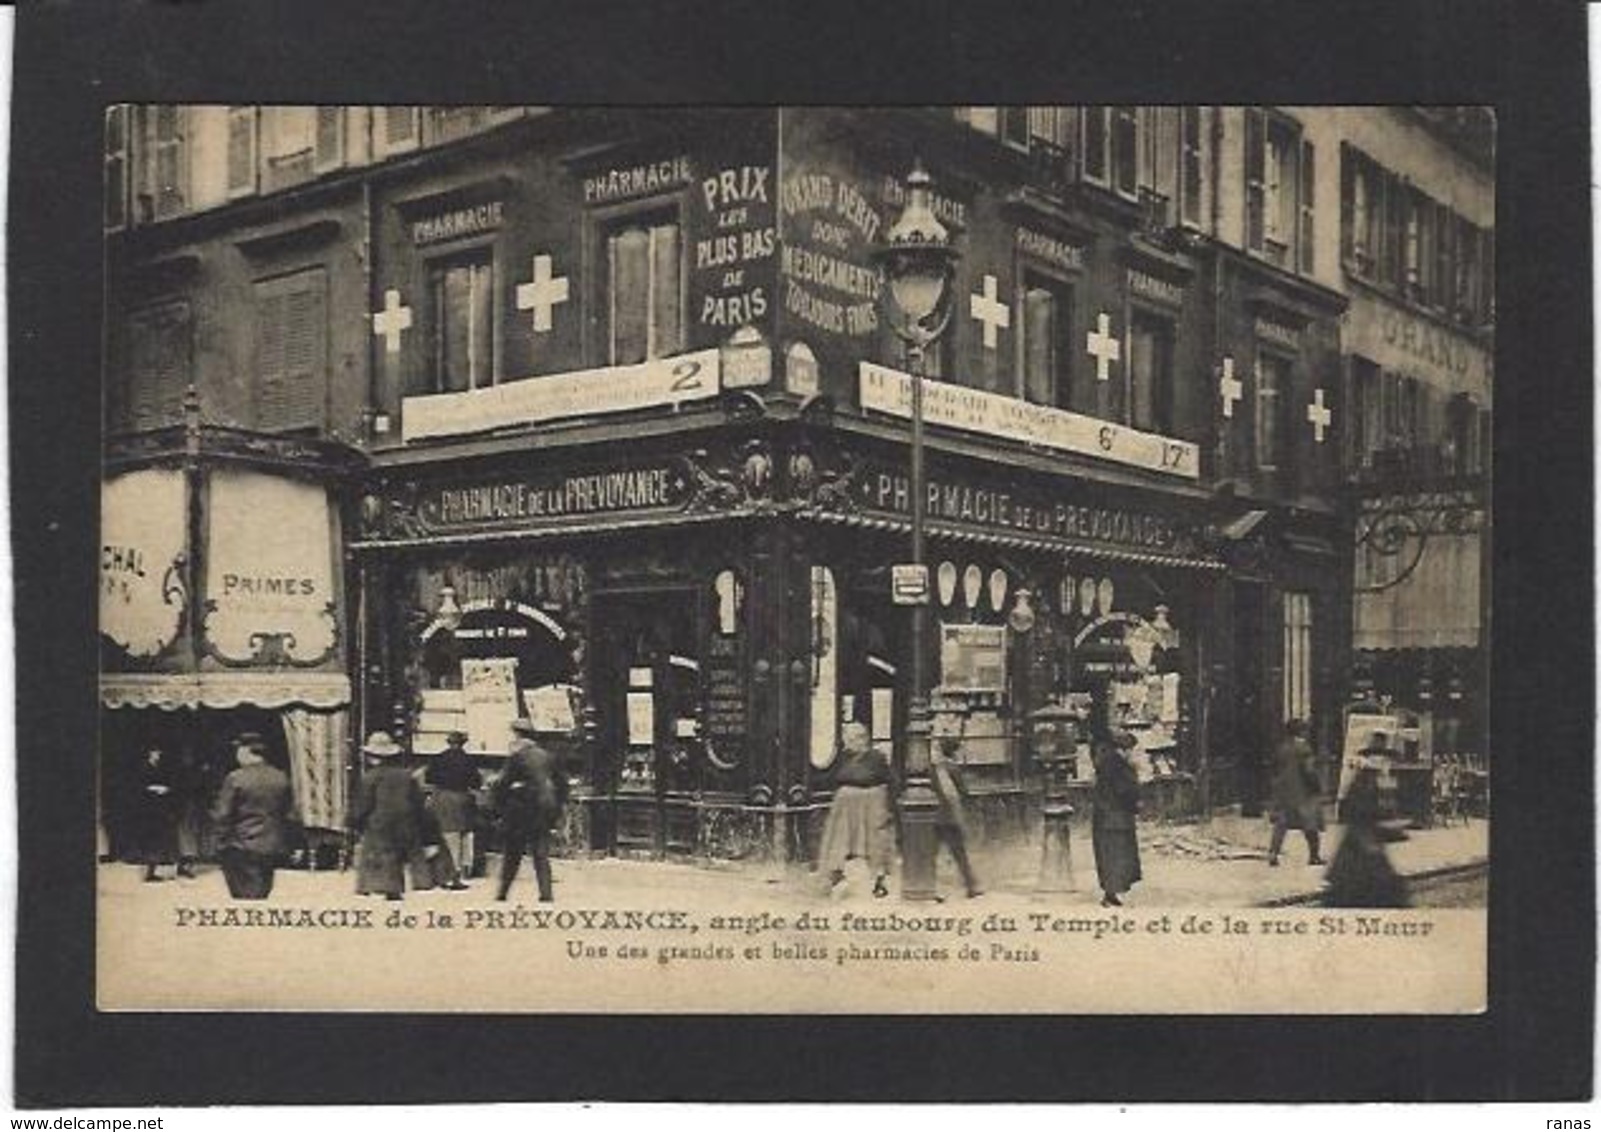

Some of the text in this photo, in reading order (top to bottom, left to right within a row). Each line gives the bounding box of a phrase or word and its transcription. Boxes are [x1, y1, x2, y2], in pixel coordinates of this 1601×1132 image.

[584, 156, 694, 201] PHARMACIE
[702, 166, 769, 211] PRIX
[414, 201, 502, 243] PHARMACIE
[698, 228, 775, 268] PLUS BAS
[723, 270, 744, 287] DE
[701, 287, 768, 326] PARIS
[670, 361, 702, 392] 2
[441, 483, 526, 521] PHARMACIE
[548, 490, 564, 514] LA
[877, 474, 1011, 526] PHRMACIE
[222, 574, 316, 596] PRIMES
